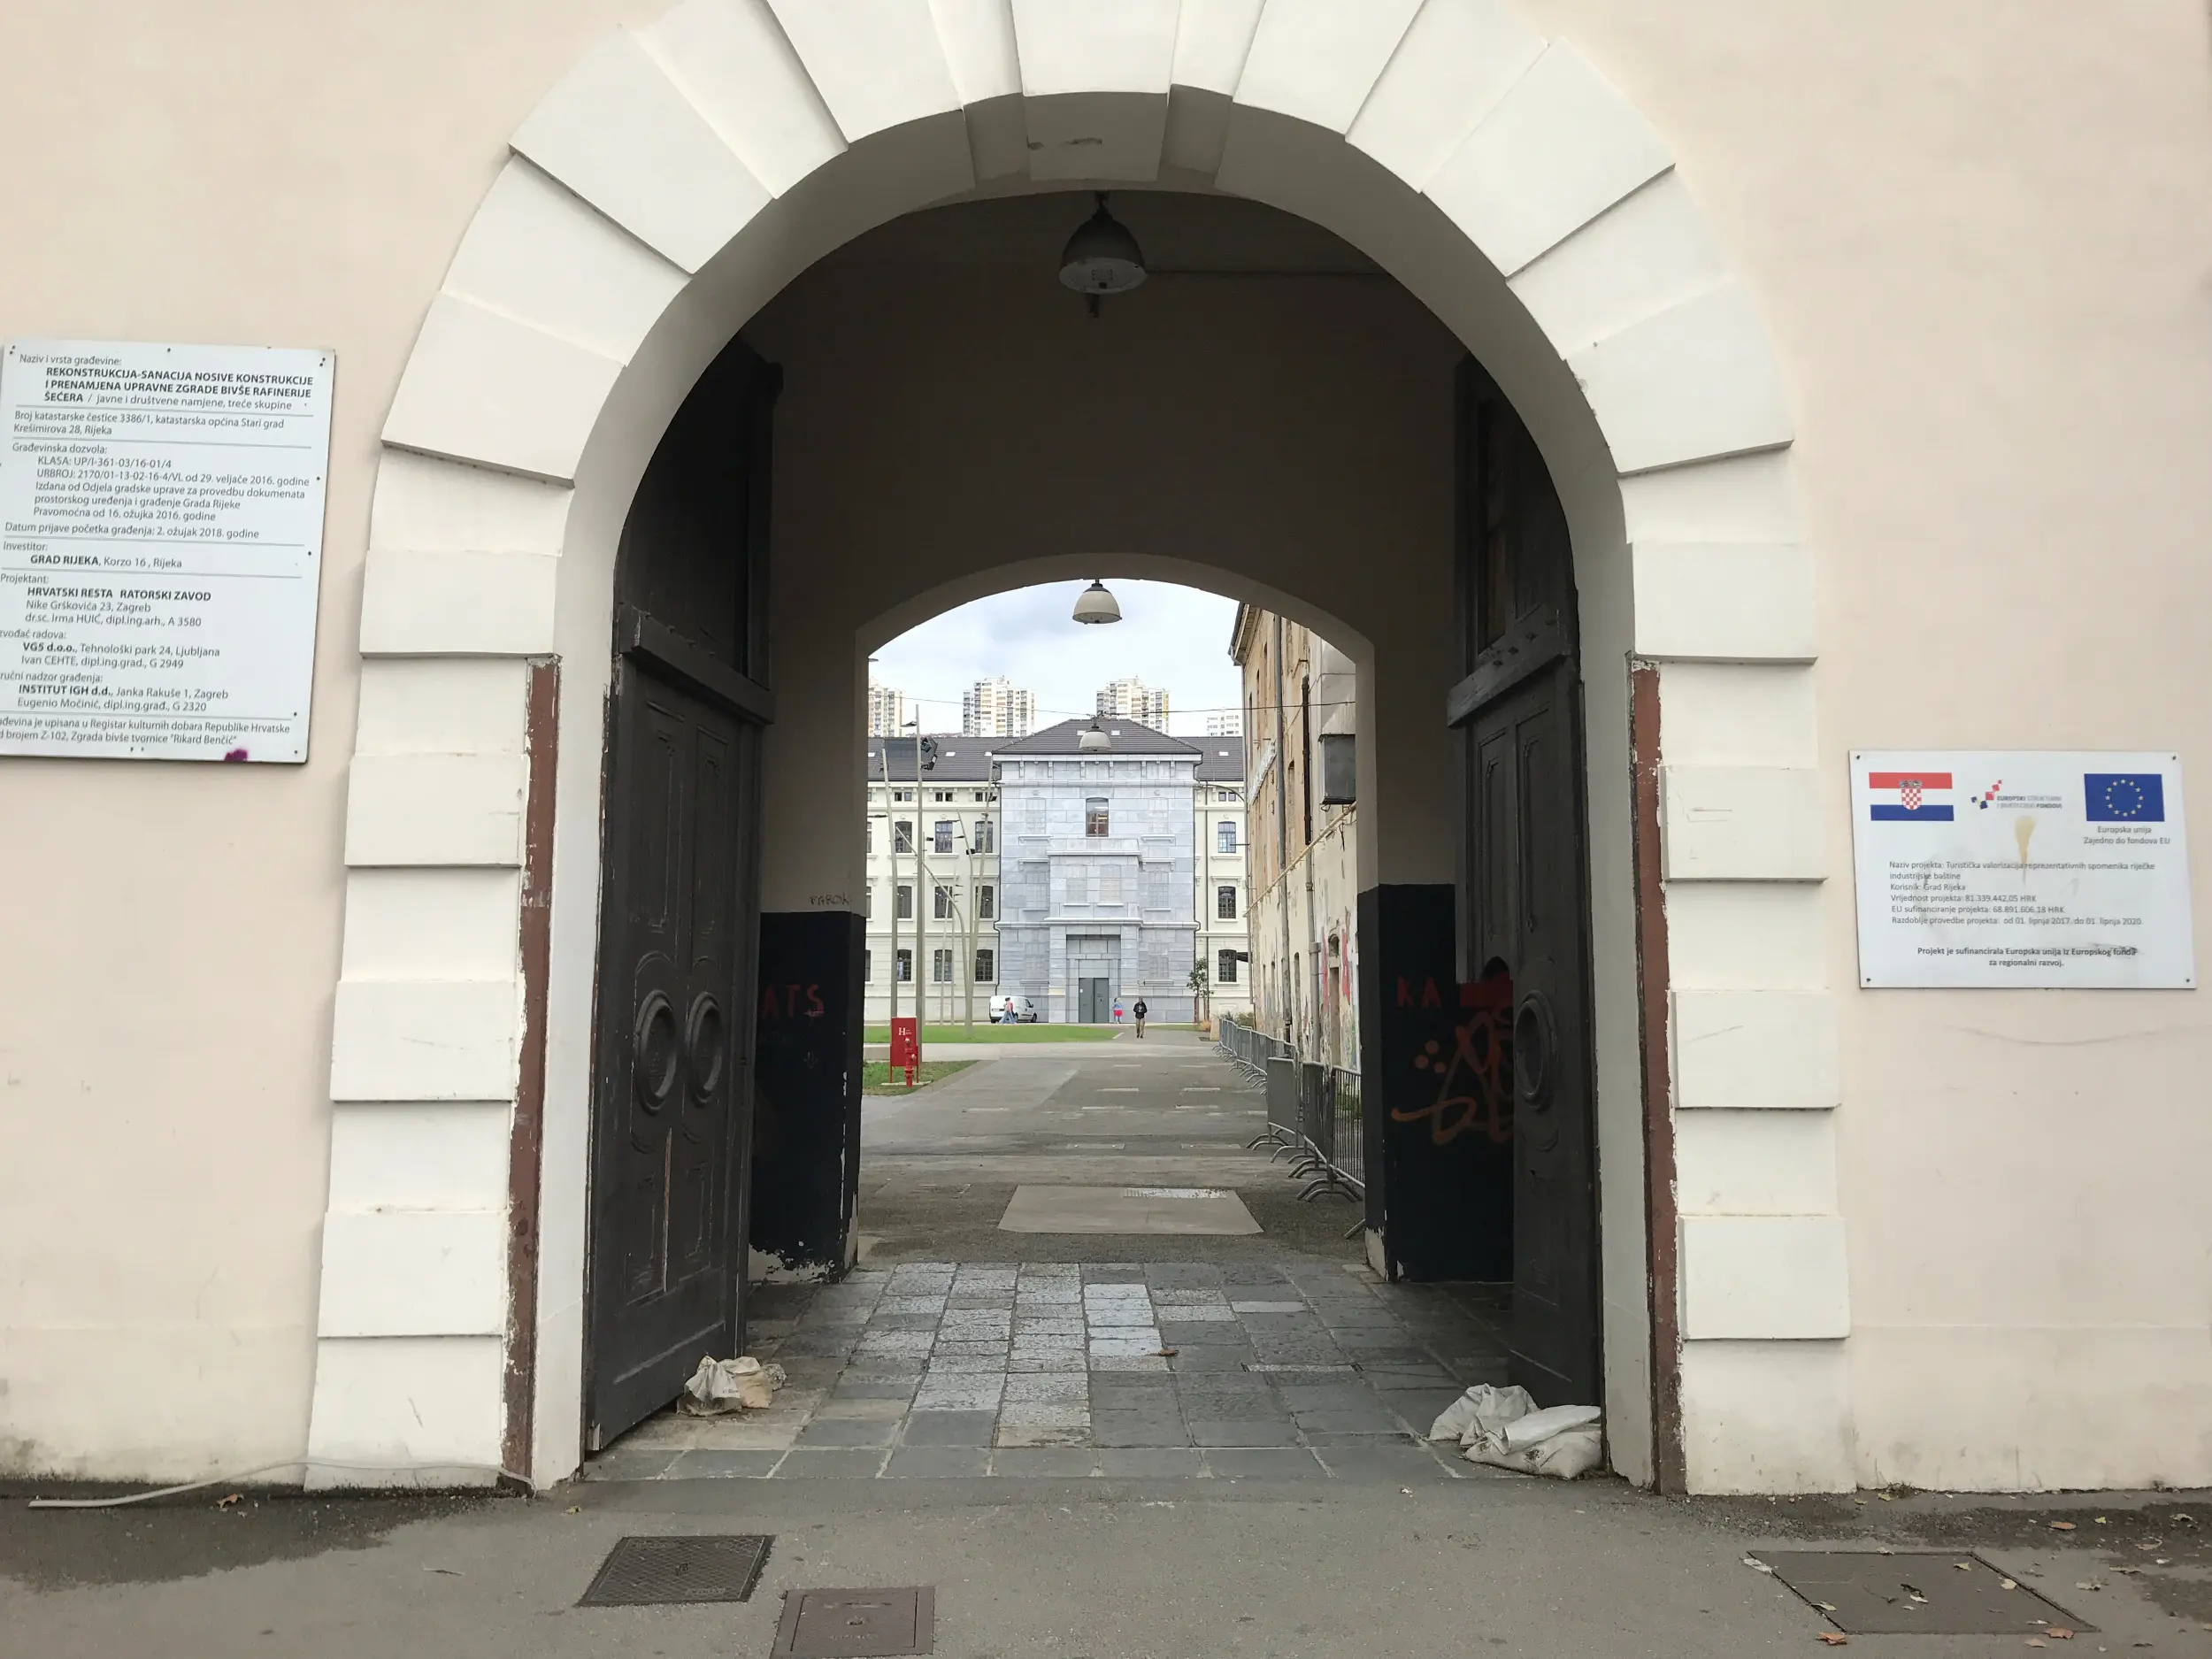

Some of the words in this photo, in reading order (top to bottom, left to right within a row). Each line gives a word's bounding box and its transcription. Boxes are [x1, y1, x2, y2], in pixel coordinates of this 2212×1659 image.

[19, 354, 44, 365] Naziv
[50, 355, 73, 365] vrsta
[46, 366, 193, 381] REKONSTRUKCIJA-SANACIJA
[195, 373, 234, 383] NOSIVE
[235, 373, 313, 386] KONSTRUKCIJE
[50, 380, 122, 391] PRENAMJENA
[124, 382, 173, 393] UPRAVNE
[175, 384, 219, 395] ZGRADE
[220, 383, 250, 396] BIVŠE
[253, 387, 311, 398] RAFINERIJE
[44, 390, 84, 403] ŠEĆERA
[96, 394, 123, 406] javne
[130, 396, 179, 406] društvene
[180, 397, 226, 411] namjene,
[227, 398, 252, 409] treće
[254, 400, 292, 412] skupine
[15, 411, 33, 423] Broj
[35, 411, 85, 422] katastarske
[86, 413, 118, 423] čestice
[120, 414, 154, 426] 3386/1,
[155, 415, 206, 426] katastarska
[208, 417, 239, 429] općina
[241, 418, 262, 427] Stari
[263, 419, 285, 431] grad
[13, 423, 67, 434] Krešimirova
[69, 425, 82, 435] 28,
[85, 425, 112, 437] Rijeka
[12, 442, 67, 453] Građevinska
[69, 444, 108, 454] dozvola:
[36, 468, 76, 480] URBROJ:
[185, 473, 198, 483] od
[216, 474, 248, 487] veljače
[250, 475, 275, 486] 2016.
[276, 476, 310, 488] godine
[67, 482, 81, 492] od
[82, 482, 112, 495] Odjela
[114, 484, 151, 496] gradske
[153, 487, 186, 497] uprave
[199, 487, 245, 499] provedbu
[246, 488, 305, 499] dokumenata
[35, 494, 89, 507] prostorskog
[91, 495, 133, 509] uređenja
[182, 498, 211, 509] Grada
[212, 499, 241, 511] Rijeke
[34, 506, 91, 518] Pravomoćna
[92, 508, 105, 518] od
[109, 509, 121, 518] 16.
[123, 509, 154, 521] ožujka
[156, 510, 181, 520] 2016.
[182, 511, 216, 523] godine
[5, 521, 37, 532] Datum
[38, 523, 70, 535] prijave
[166, 526, 197, 539] ožujak
[199, 527, 225, 538] 2018.
[227, 528, 260, 541] godine
[30, 555, 61, 565] GRAD
[63, 556, 102, 567] RIJEKA,
[104, 557, 132, 567] Korzo
[152, 558, 182, 571] Rijeka
[27, 587, 79, 598] HRVATSKI
[120, 589, 172, 600] RATORSKI
[174, 590, 211, 601] ZAVOD
[26, 600, 48, 611] Nike
[100, 602, 114, 613] 23,
[116, 603, 151, 615] Zagreb
[51, 614, 74, 624] Irma
[178, 618, 202, 627] 3580
[32, 629, 66, 640] radova:
[81, 644, 133, 655] Tehnološki
[134, 645, 157, 657] park
[159, 646, 173, 657] 24,
[175, 646, 220, 659] Ljubljana
[21, 655, 42, 664] Ivan
[159, 659, 184, 669] 2949
[26, 672, 58, 682] nadzor
[19, 685, 67, 695] INSTITUT
[69, 686, 88, 696] IGH
[116, 687, 144, 697] Janka
[146, 687, 180, 698] Rakuše
[194, 689, 229, 702] Zagreb
[18, 697, 58, 710] Eugenio
[183, 702, 207, 711] 2320
[44, 717, 80, 730] upisana
[90, 718, 127, 731] Registar
[128, 719, 170, 730] kulturnih
[171, 720, 203, 731] dobara
[204, 721, 250, 733] Republike
[251, 722, 290, 733] Hrvatske
[6, 728, 39, 741] brojem
[71, 730, 104, 742] Zgrada
[105, 731, 129, 741] bivše
[131, 732, 168, 742] tvornice
